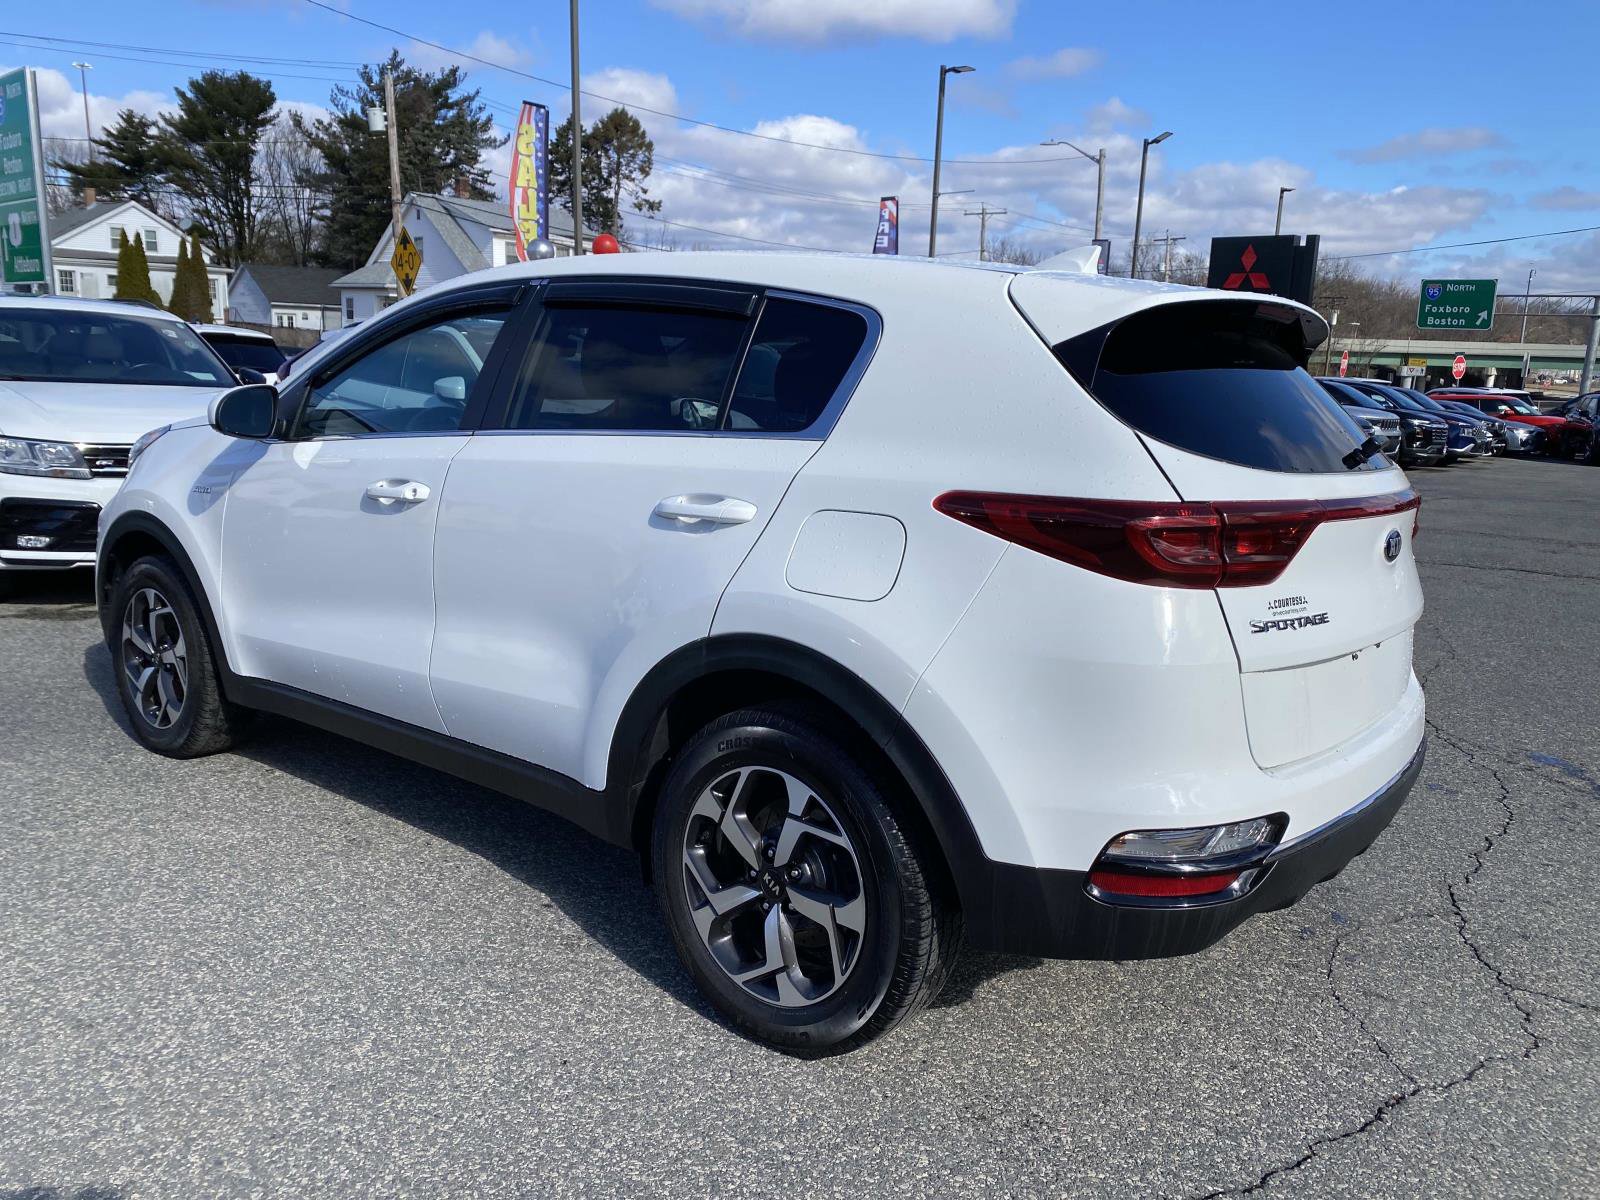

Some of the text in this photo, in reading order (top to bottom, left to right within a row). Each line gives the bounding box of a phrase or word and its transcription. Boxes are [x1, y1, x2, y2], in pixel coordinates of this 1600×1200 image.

[1428, 283, 1476, 296] 95 NORTH
[1425, 304, 1471, 313] Foxboro
[1427, 316, 1466, 326] Boston
[1249, 612, 1331, 634] SPORTAGE
[762, 872, 780, 896] KIA
